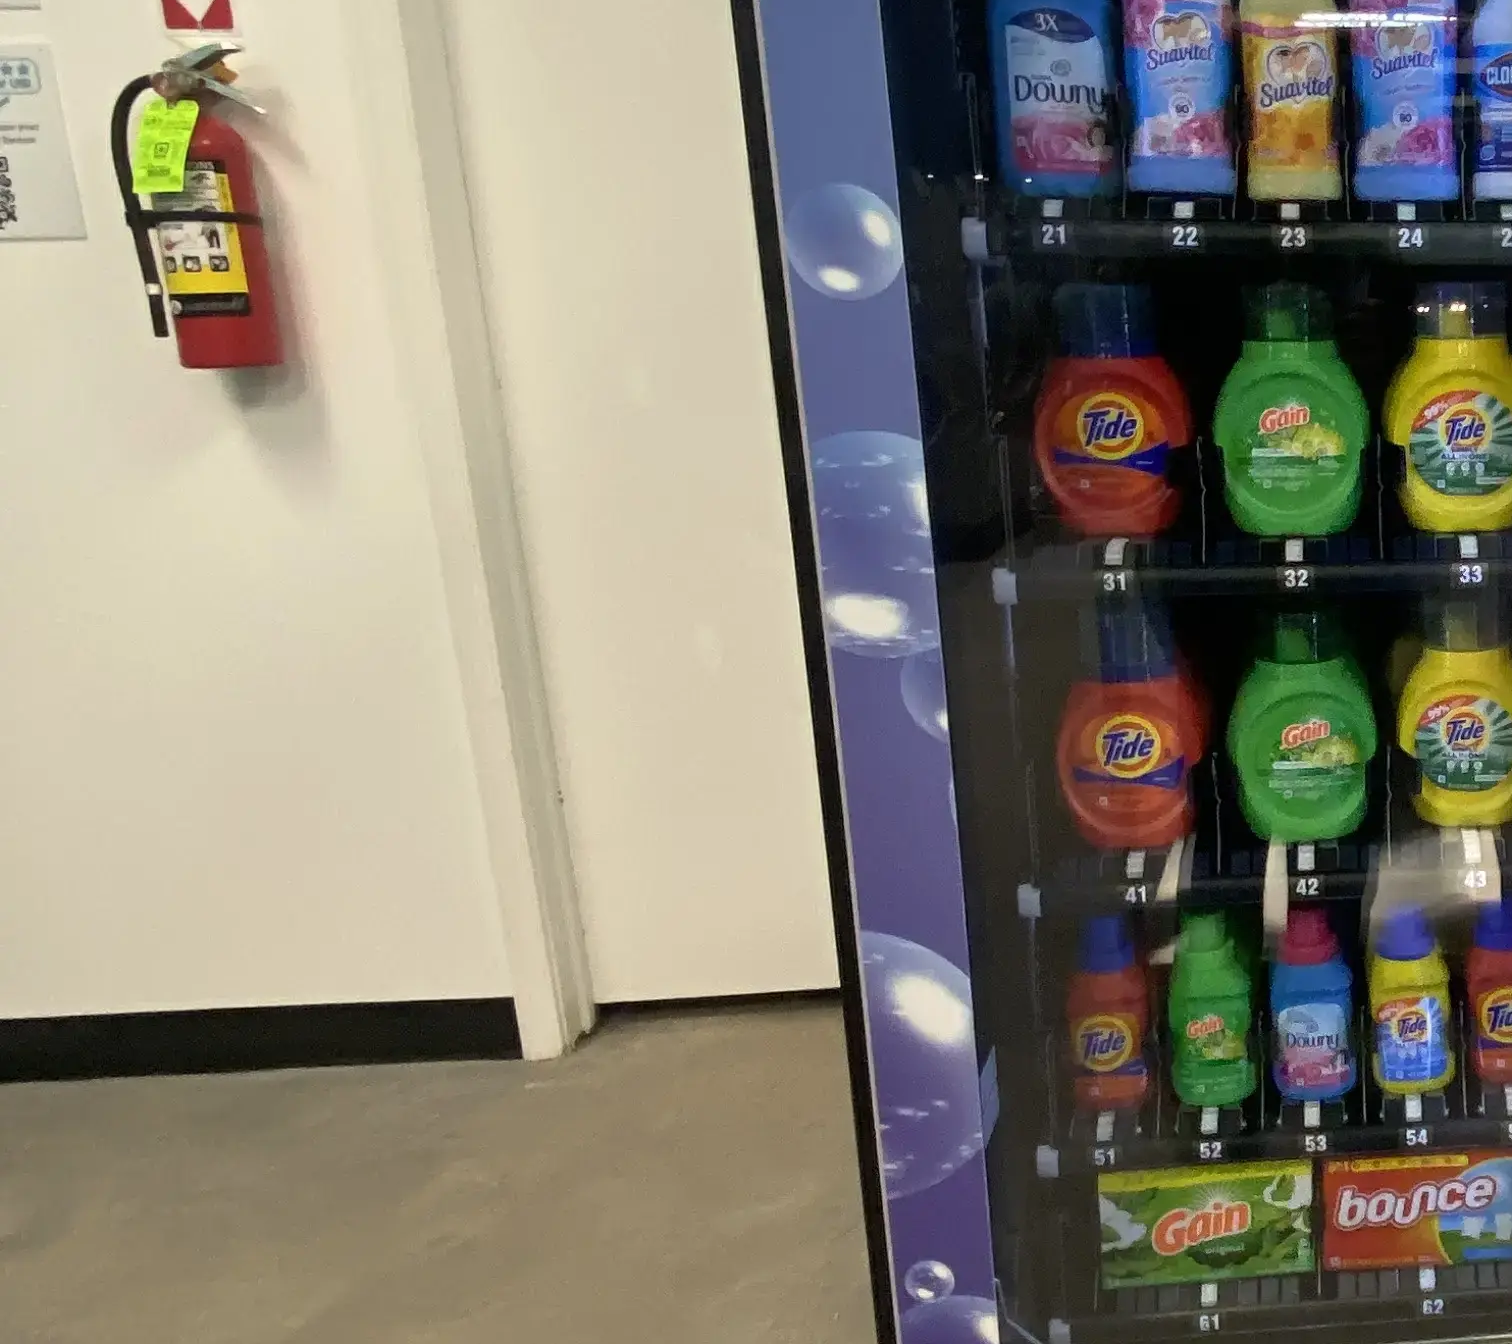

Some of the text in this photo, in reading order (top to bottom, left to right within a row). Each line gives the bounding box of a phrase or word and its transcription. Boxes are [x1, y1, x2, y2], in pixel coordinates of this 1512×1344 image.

[1033, 13, 1059, 33] 3X
[1146, 42, 1214, 72] Suavitel
[1371, 48, 1438, 80] Suavitel
[1013, 74, 1109, 116] Downy
[1260, 75, 1334, 108] Suavitel
[1042, 224, 1067, 245] 21
[1172, 225, 1200, 247] 22
[1281, 227, 1307, 248] 23
[1398, 227, 1424, 248] 24
[1083, 408, 1138, 447] Tide
[1260, 407, 1310, 433] Gain
[1445, 416, 1486, 446] Tide
[1103, 565, 1483, 591] 31 32 33
[1281, 720, 1331, 750] Gain
[1447, 719, 1486, 745] Tide
[1103, 730, 1155, 767] Tide
[1125, 869, 1487, 904] 41 42 43
[1187, 1016, 1224, 1038] Gain
[1286, 1032, 1340, 1049] Downy
[1397, 1014, 1428, 1039] Tide
[1080, 1030, 1127, 1061] Tide
[1094, 1147, 1116, 1166] 51
[1200, 1140, 1223, 1160] 52
[1304, 1134, 1328, 1153] 53
[1405, 1127, 1429, 1146] 54
[1333, 1174, 1498, 1232] bounce
[1152, 1201, 1252, 1256] Gain
[1199, 1298, 1444, 1332] 61 62
